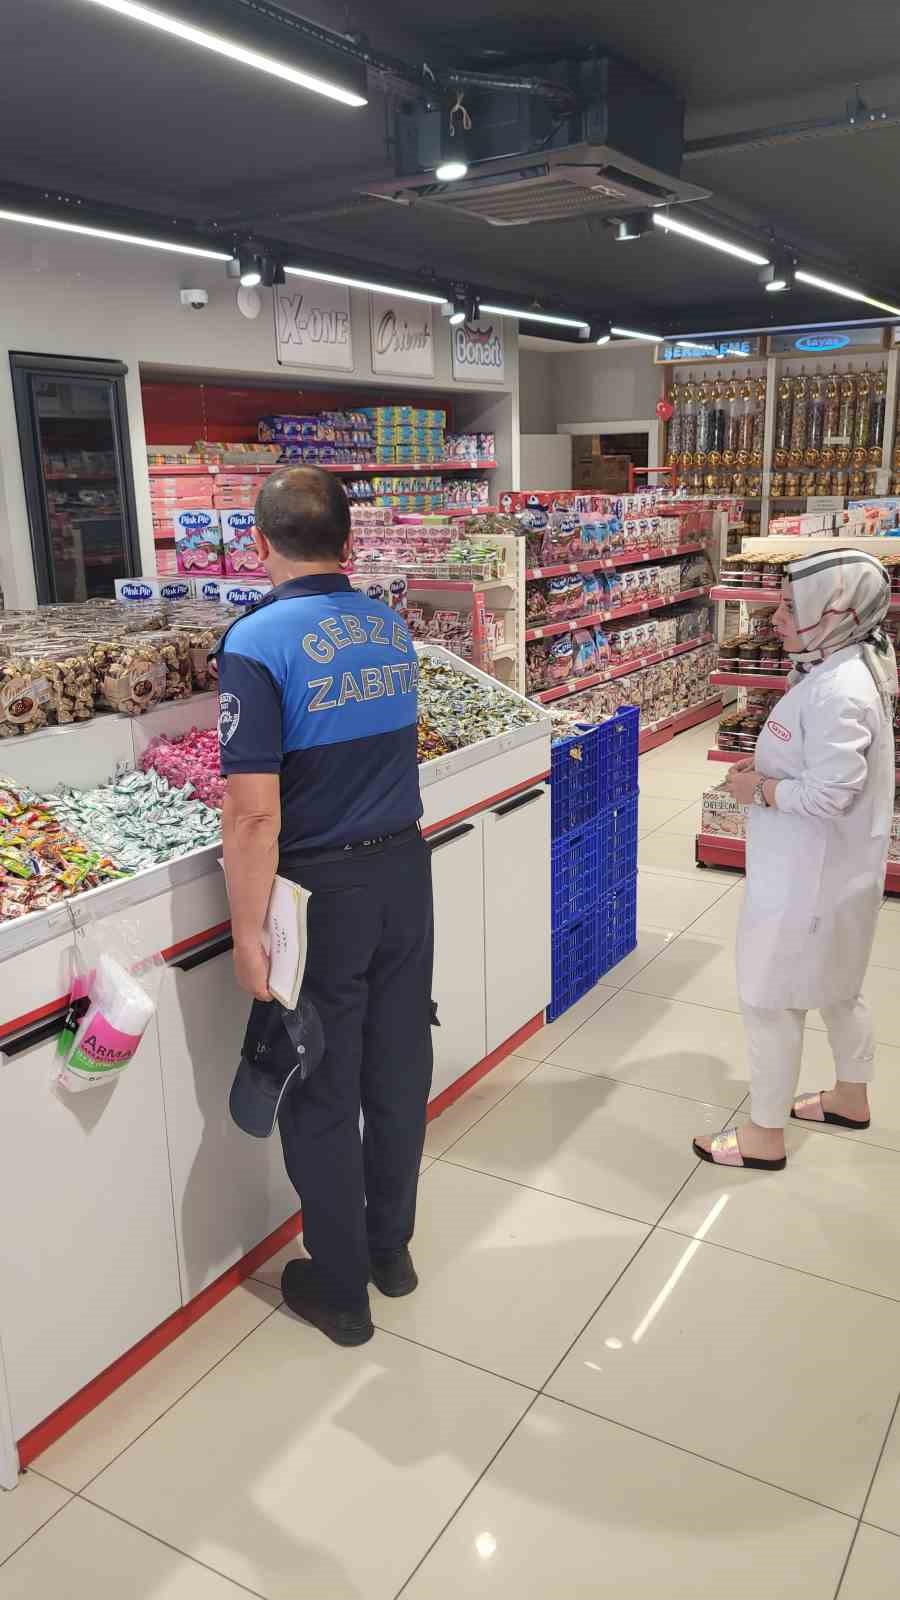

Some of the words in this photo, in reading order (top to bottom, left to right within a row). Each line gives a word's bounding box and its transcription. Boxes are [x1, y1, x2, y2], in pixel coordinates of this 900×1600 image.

[278, 294, 348, 345] X-ONE
[455, 327, 502, 367] Bonart
[180, 513, 198, 526] Pink
[198, 512, 211, 525] Pie
[229, 513, 247, 526] Pink
[228, 591, 247, 601] Pink
[302, 614, 408, 664] GEBZE
